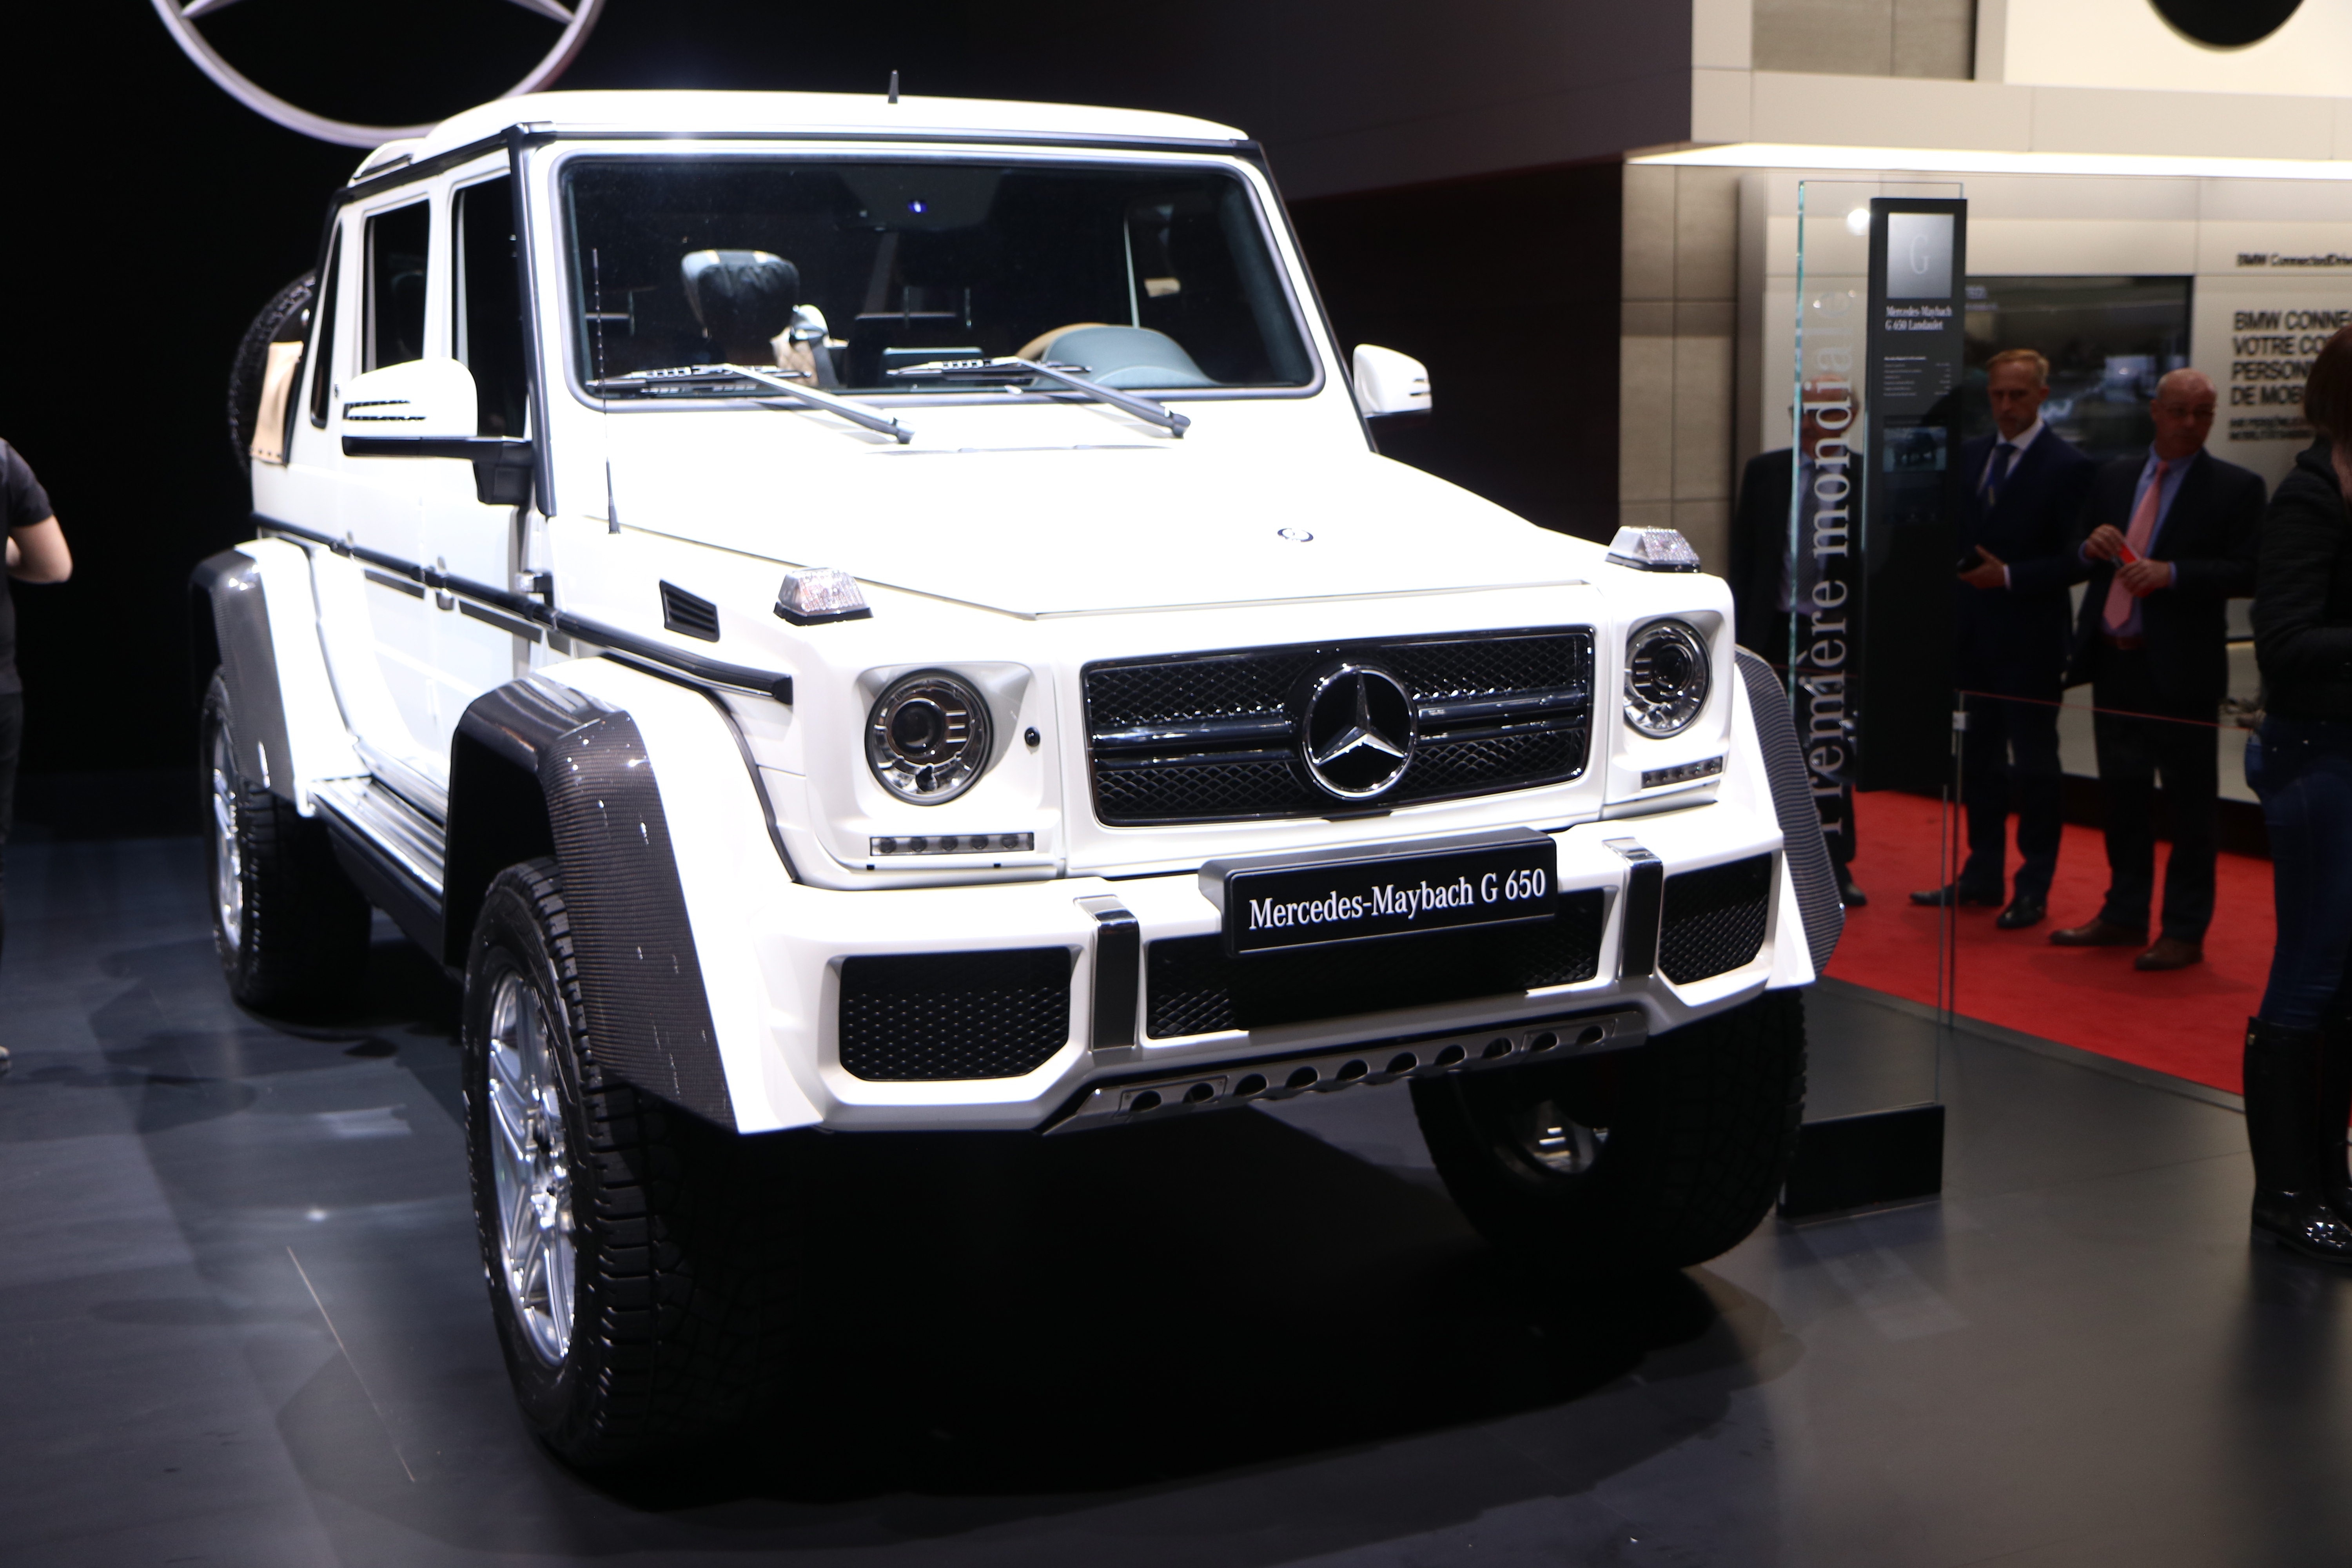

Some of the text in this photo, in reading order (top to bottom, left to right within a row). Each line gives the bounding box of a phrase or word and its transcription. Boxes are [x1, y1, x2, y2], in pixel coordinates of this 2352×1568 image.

[2237, 253, 2266, 267] BMW
[1884, 319, 1893, 331] G
[2234, 310, 2352, 330] BMW CONNE
[2233, 335, 2336, 355] VOTRE CO
[2231, 385, 2256, 405] DE
[1249, 867, 1546, 931] Mercedes-Maybach G 650
